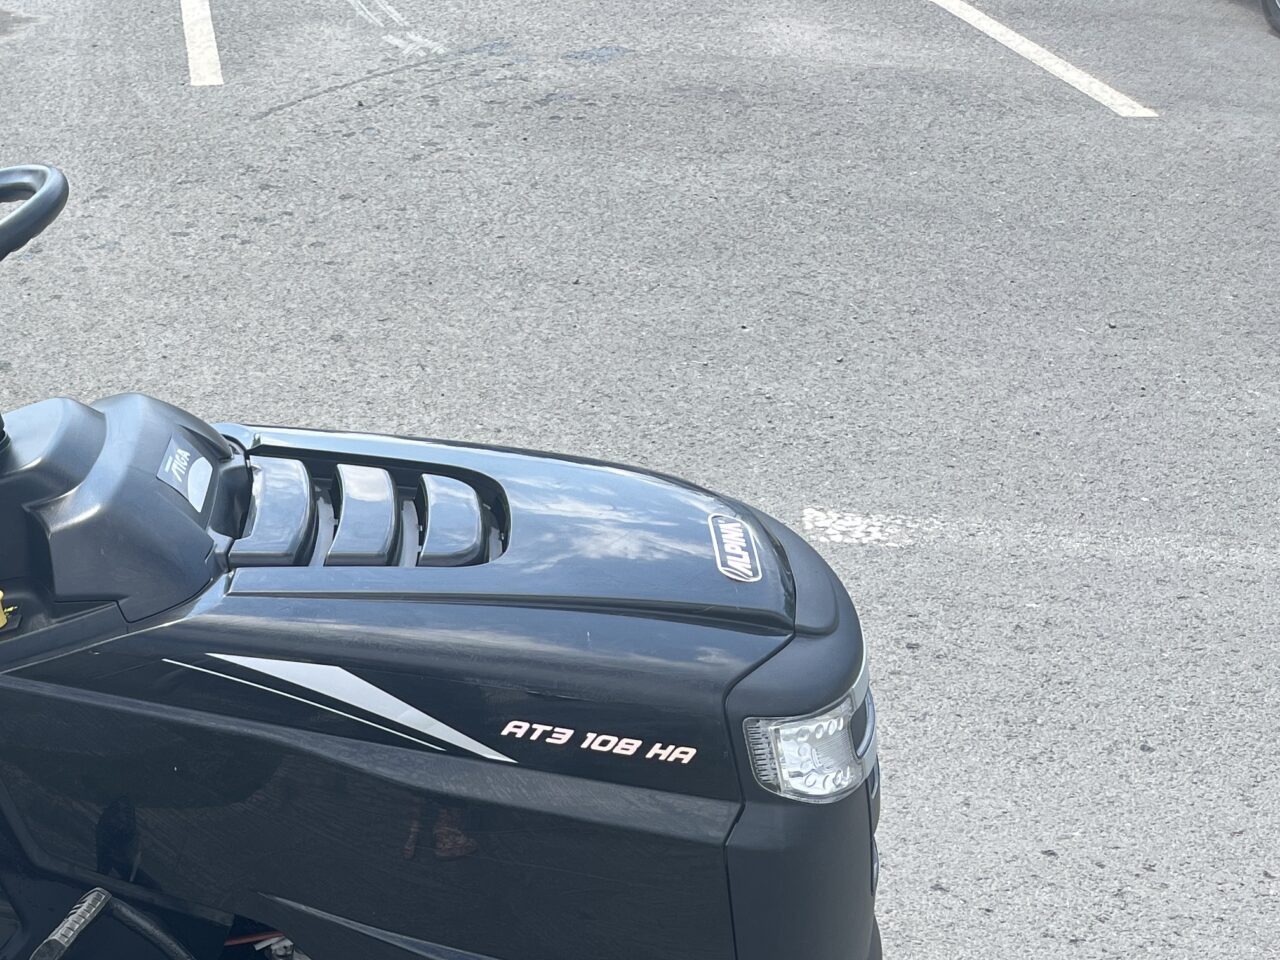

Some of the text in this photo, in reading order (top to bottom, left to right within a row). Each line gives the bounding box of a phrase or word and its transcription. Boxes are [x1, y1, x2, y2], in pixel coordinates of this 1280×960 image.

[718, 521, 754, 577] ALPINA
[500, 720, 697, 764] AT3 108 HA
